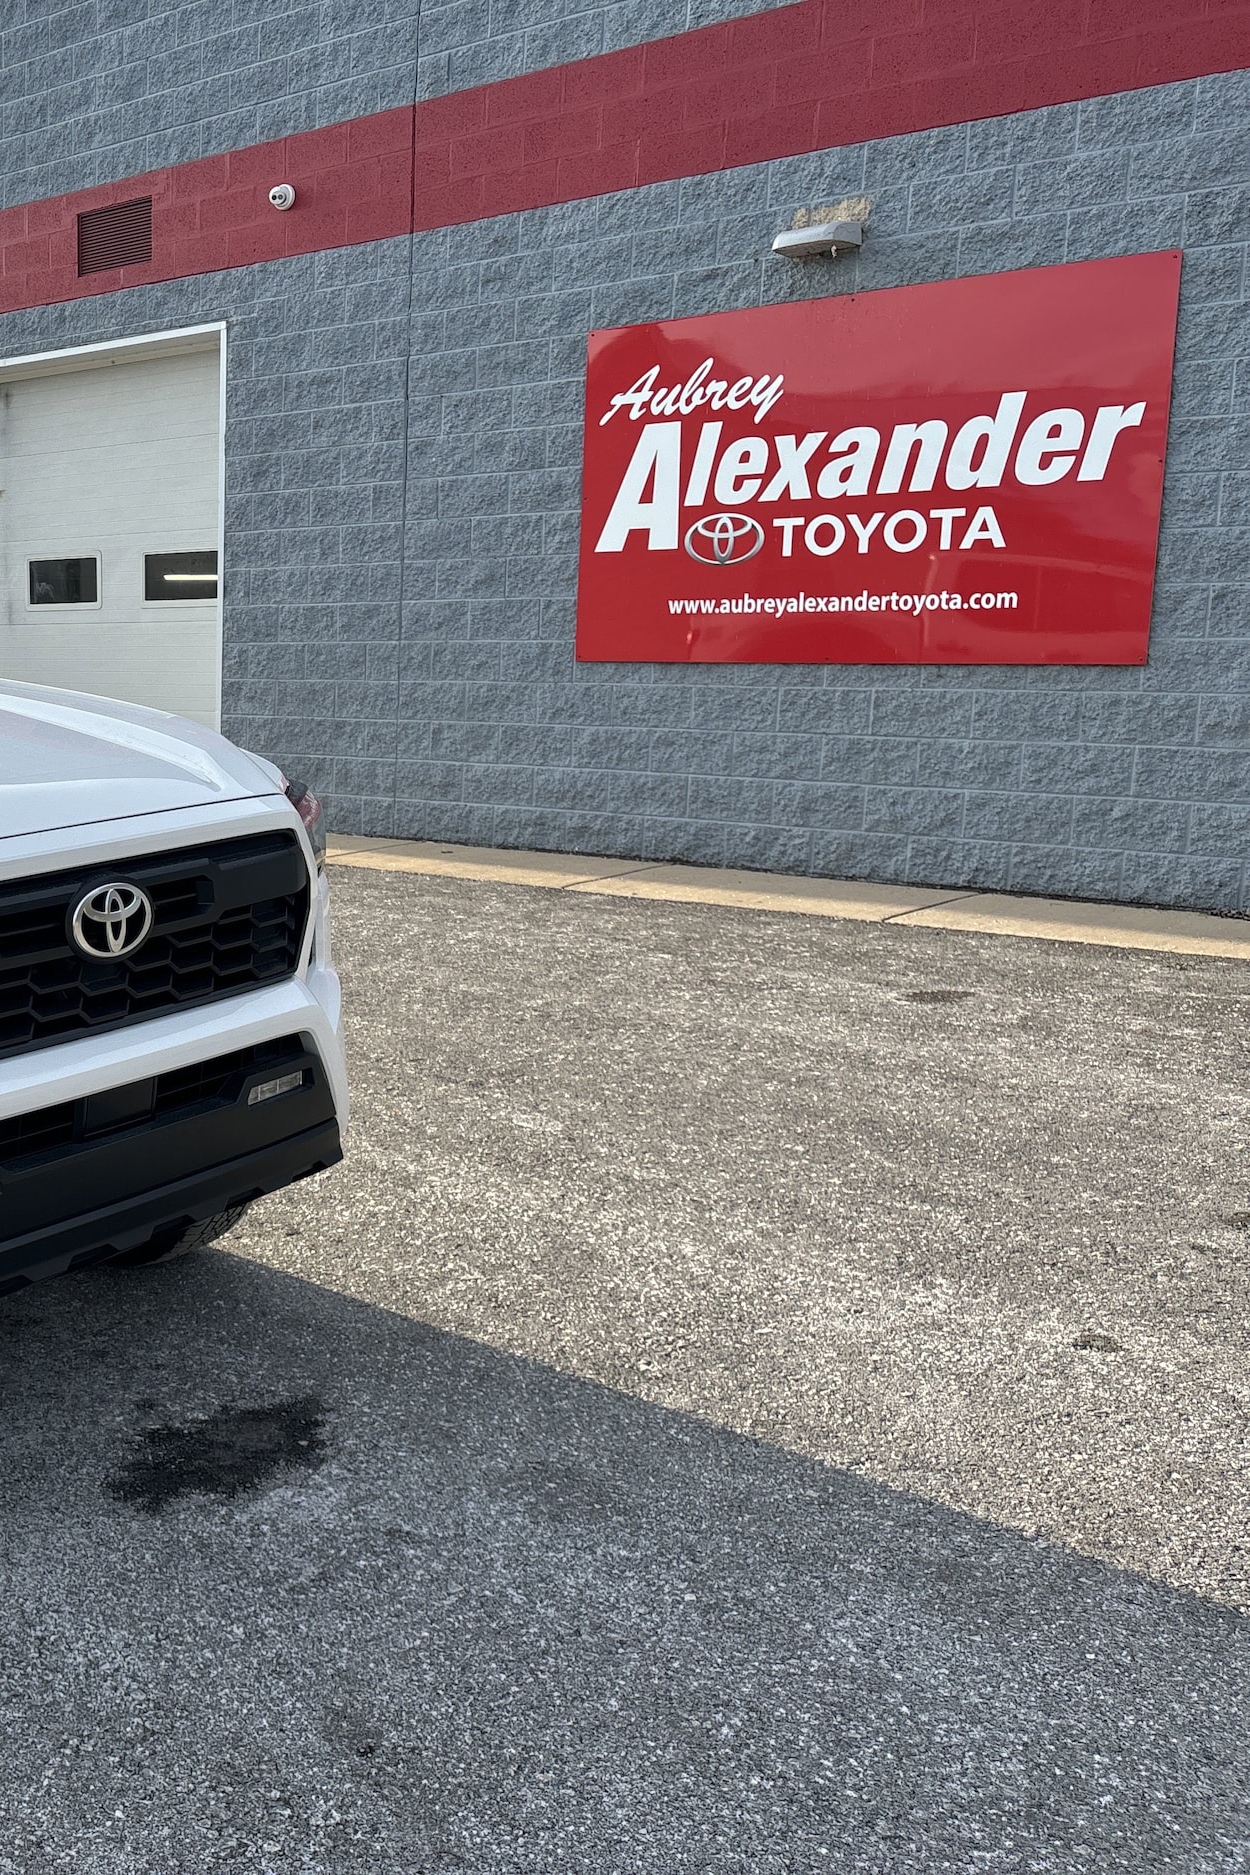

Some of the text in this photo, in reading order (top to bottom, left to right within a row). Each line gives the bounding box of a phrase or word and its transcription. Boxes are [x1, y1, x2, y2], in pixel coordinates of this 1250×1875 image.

[599, 357, 784, 426] Aubrey
[594, 391, 1147, 553] Alexander
[773, 506, 1006, 557] TOYOTA
[668, 589, 1019, 619] www.aubreyalexandertoyota.com
